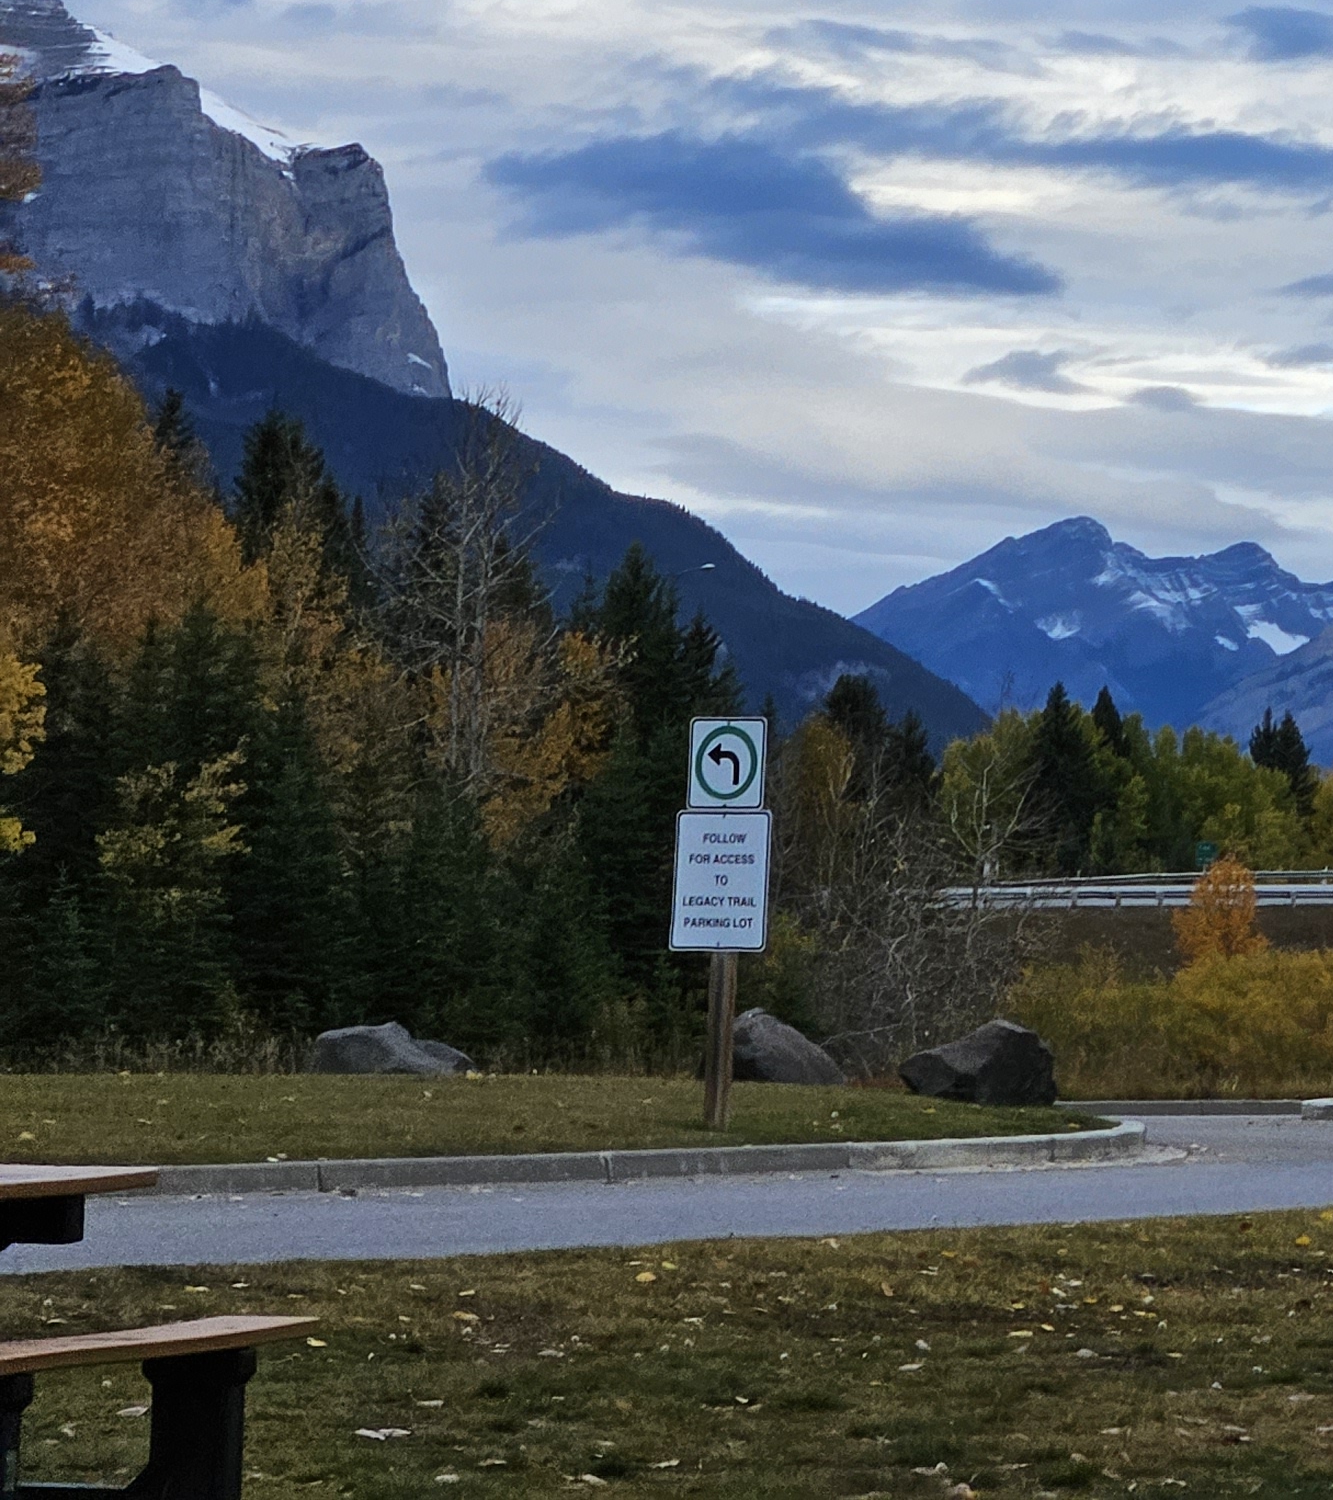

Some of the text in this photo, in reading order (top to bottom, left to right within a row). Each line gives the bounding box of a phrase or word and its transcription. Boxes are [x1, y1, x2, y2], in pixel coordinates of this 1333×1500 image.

[703, 833, 747, 844] FOLLOW
[689, 853, 755, 865] FOR ACCESS
[715, 874, 728, 886] TO
[682, 896, 757, 907] LEGACY TRAIL
[683, 917, 753, 929] PARKING LOT
